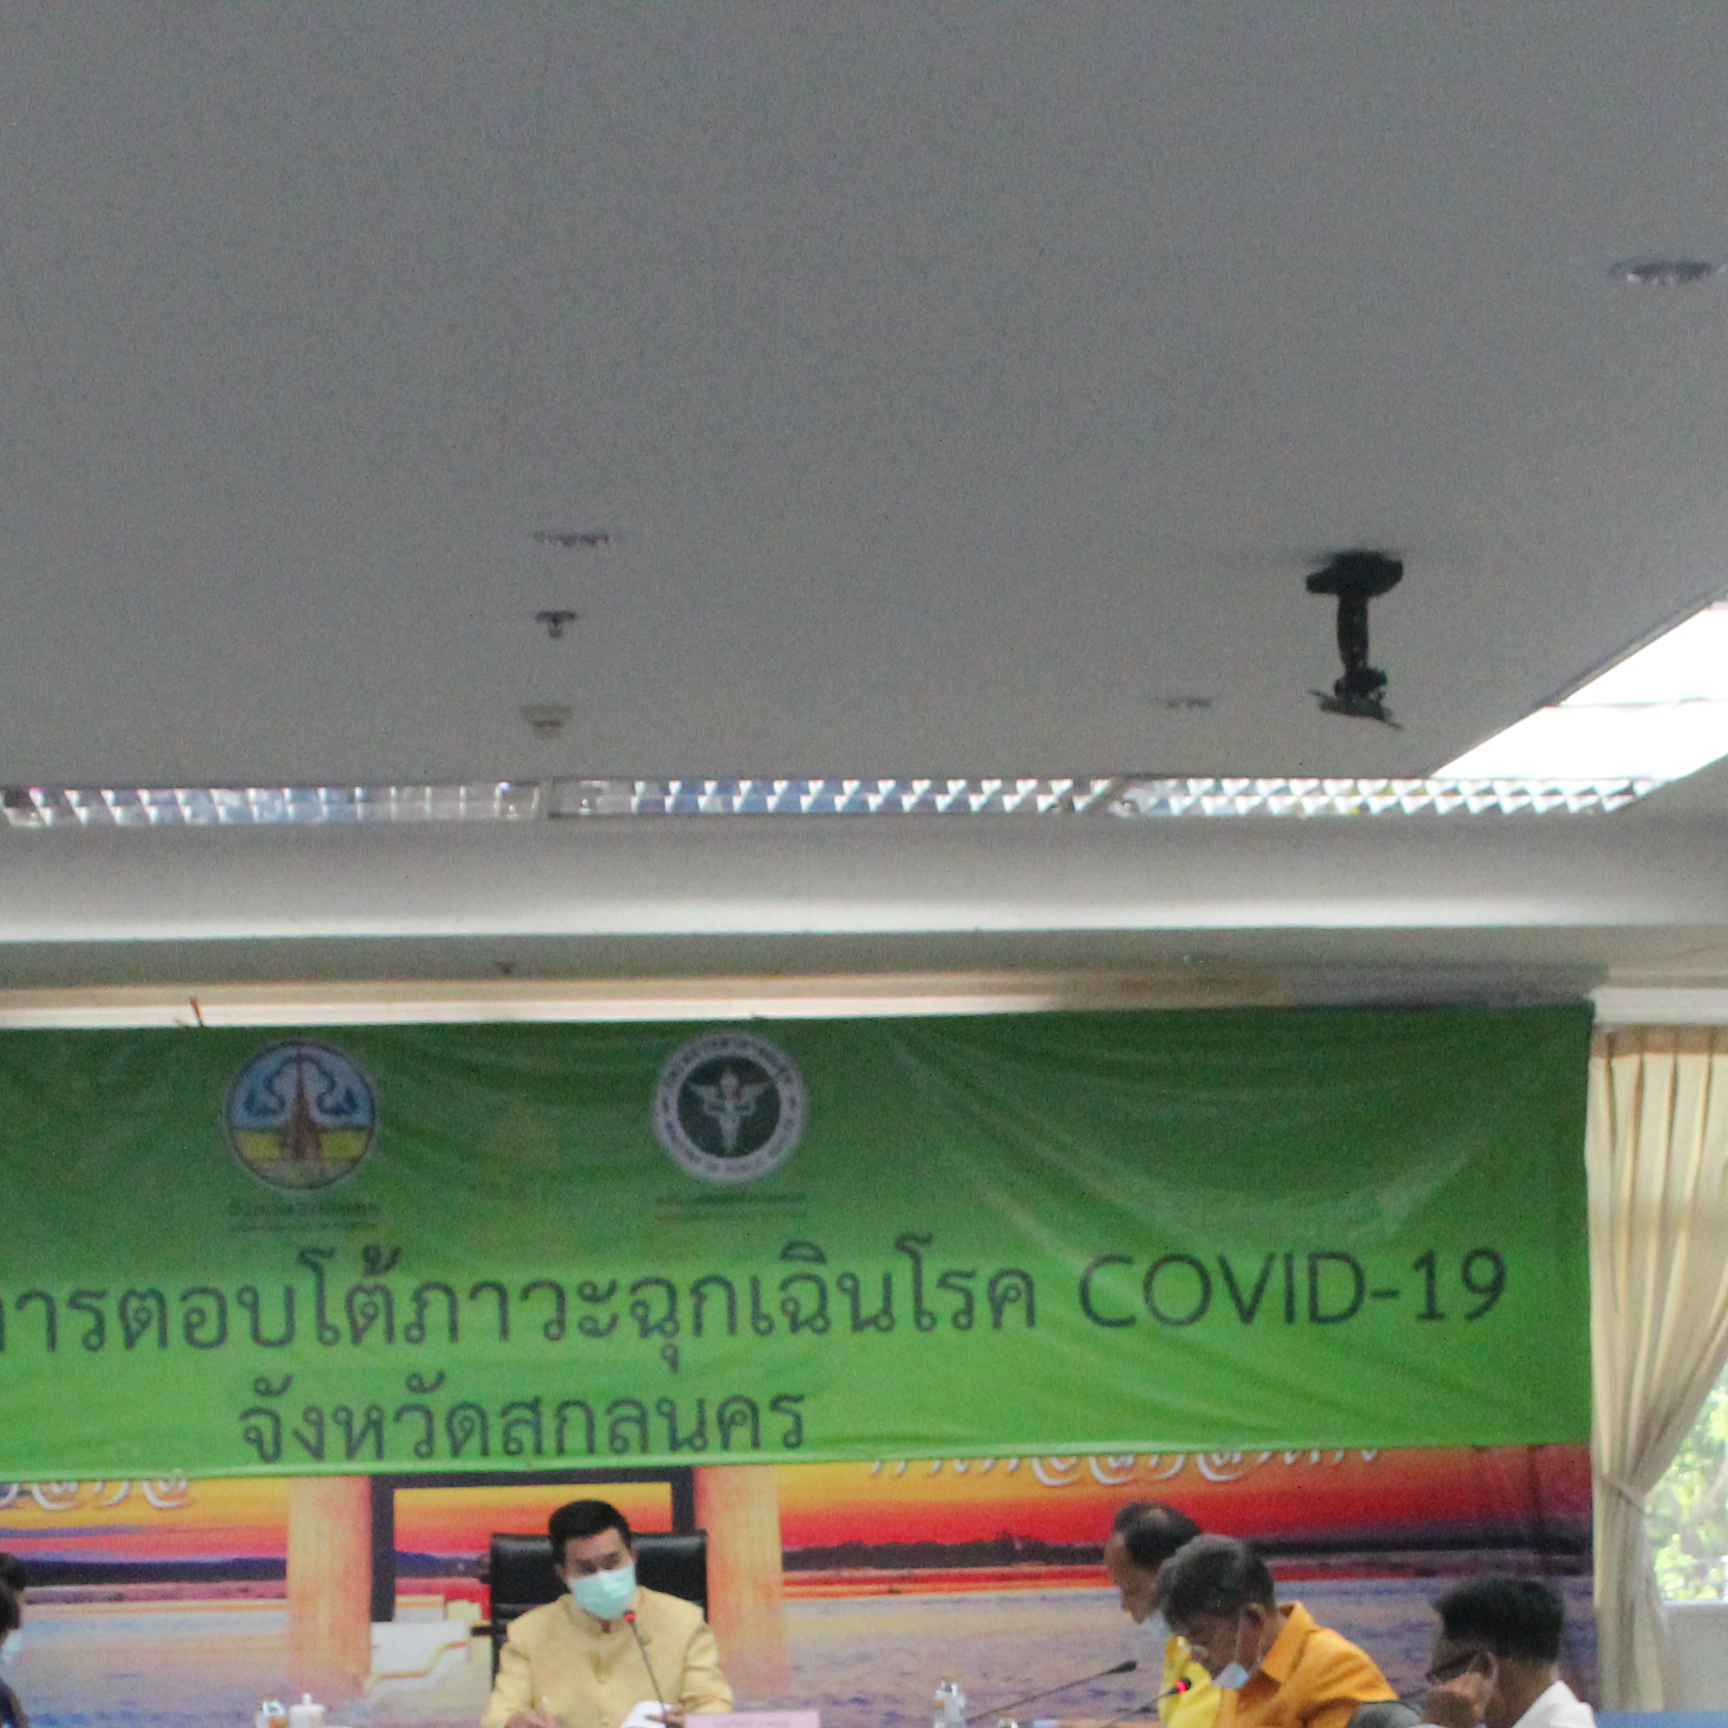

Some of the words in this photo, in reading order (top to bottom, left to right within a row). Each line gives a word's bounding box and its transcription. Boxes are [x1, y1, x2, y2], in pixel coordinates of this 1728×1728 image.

[1078, 1247, 1508, 1329] COVID-19
[237, 1370, 807, 1466] จังหวัดสกลนคร
